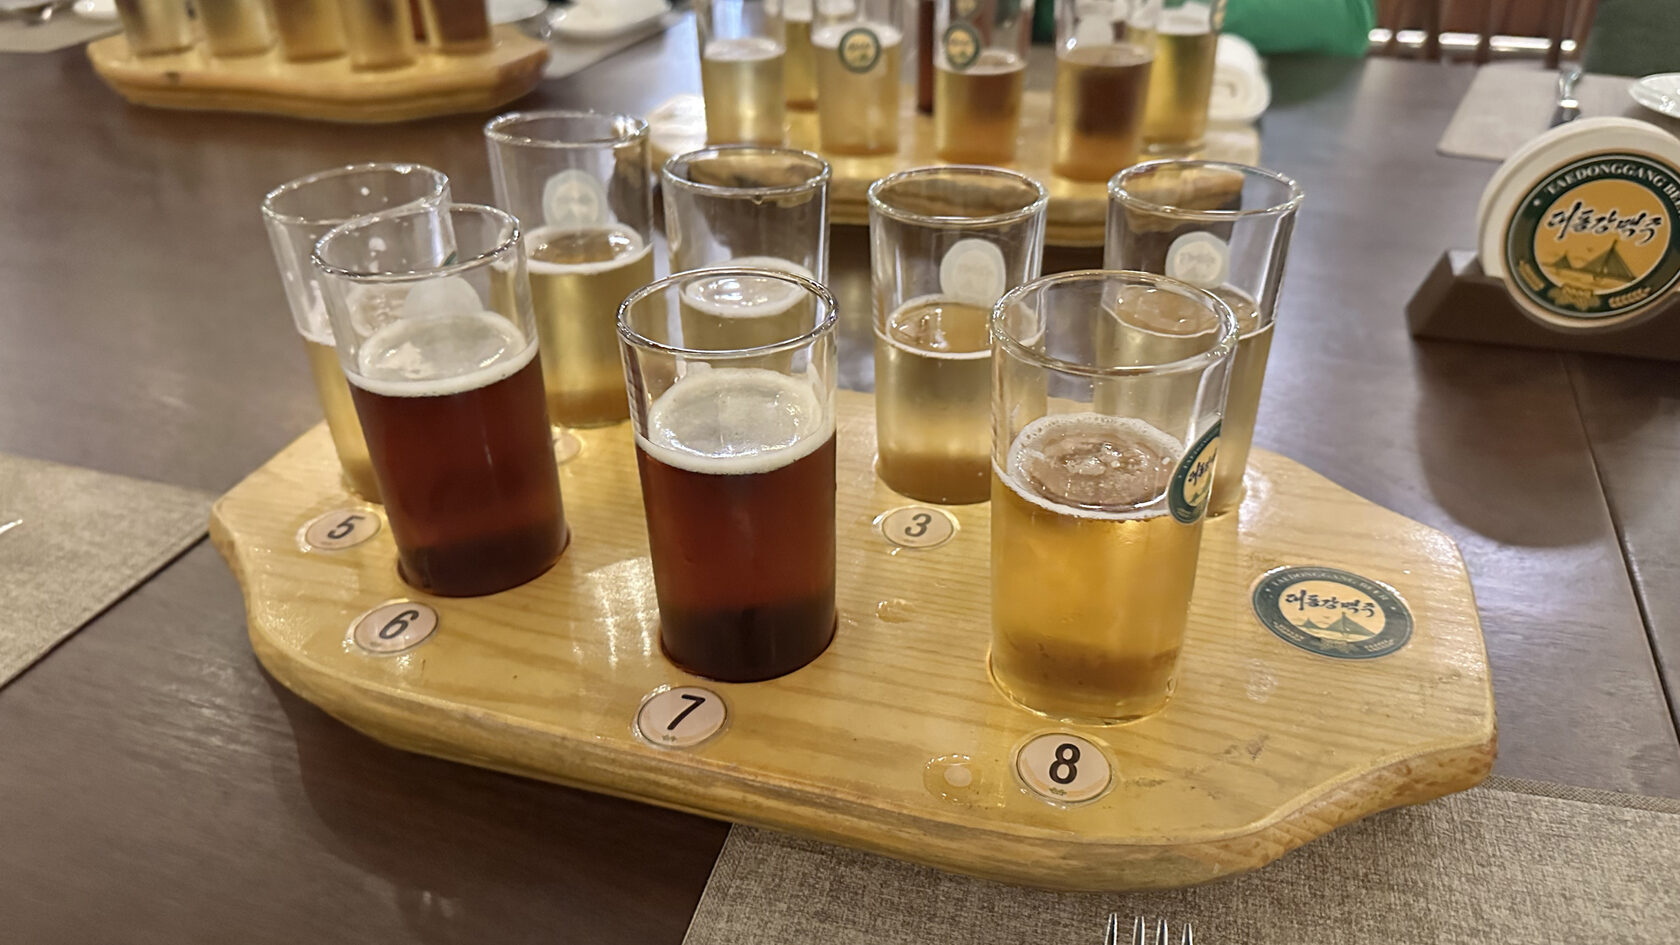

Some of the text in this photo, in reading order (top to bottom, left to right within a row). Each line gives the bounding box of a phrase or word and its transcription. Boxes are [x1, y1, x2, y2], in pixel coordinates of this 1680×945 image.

[327, 514, 366, 540] 5
[904, 512, 932, 538] 3
[378, 609, 420, 640] 6
[666, 693, 706, 731] 7
[1048, 742, 1081, 785] 8
